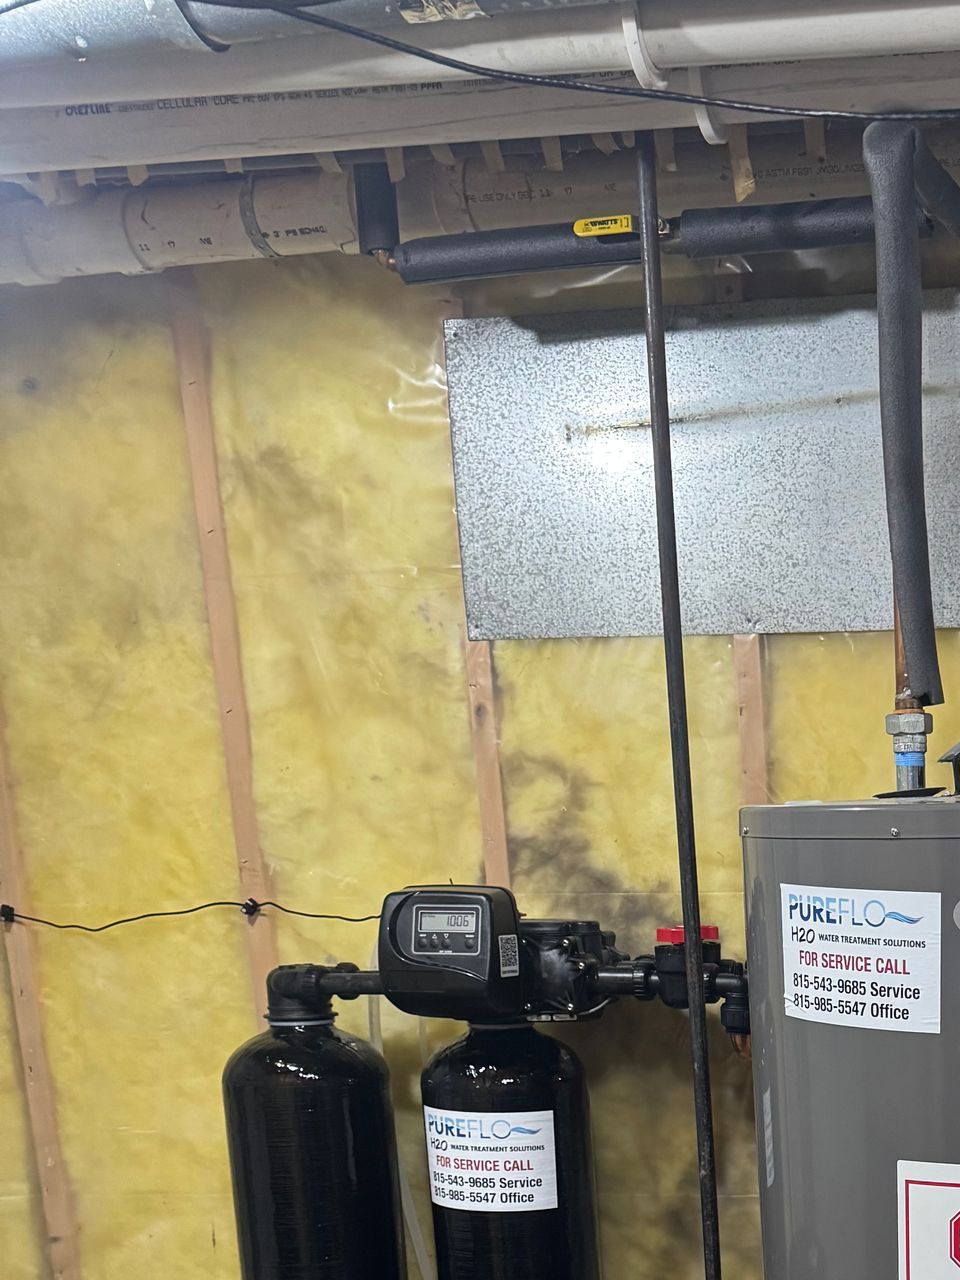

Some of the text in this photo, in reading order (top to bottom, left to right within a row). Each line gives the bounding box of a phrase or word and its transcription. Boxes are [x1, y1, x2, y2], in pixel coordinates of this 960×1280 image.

[789, 894, 886, 927] PUREFLO
[791, 926, 926, 948] H2O WATER TREATMENT SOLUTIONS
[800, 950, 910, 975] FOR SERVICE CALL
[794, 973, 920, 999] 815-543-9685 Service
[794, 993, 910, 1020] 815-985-5547 Office
[428, 1113, 511, 1139] PUREFLO
[431, 1138, 448, 1151] H2O
[437, 1155, 534, 1172] FOR SERVICE CALL
[434, 1171, 542, 1188] 815-543-9685 Service
[435, 1186, 534, 1204] 815-985-5547 Office
